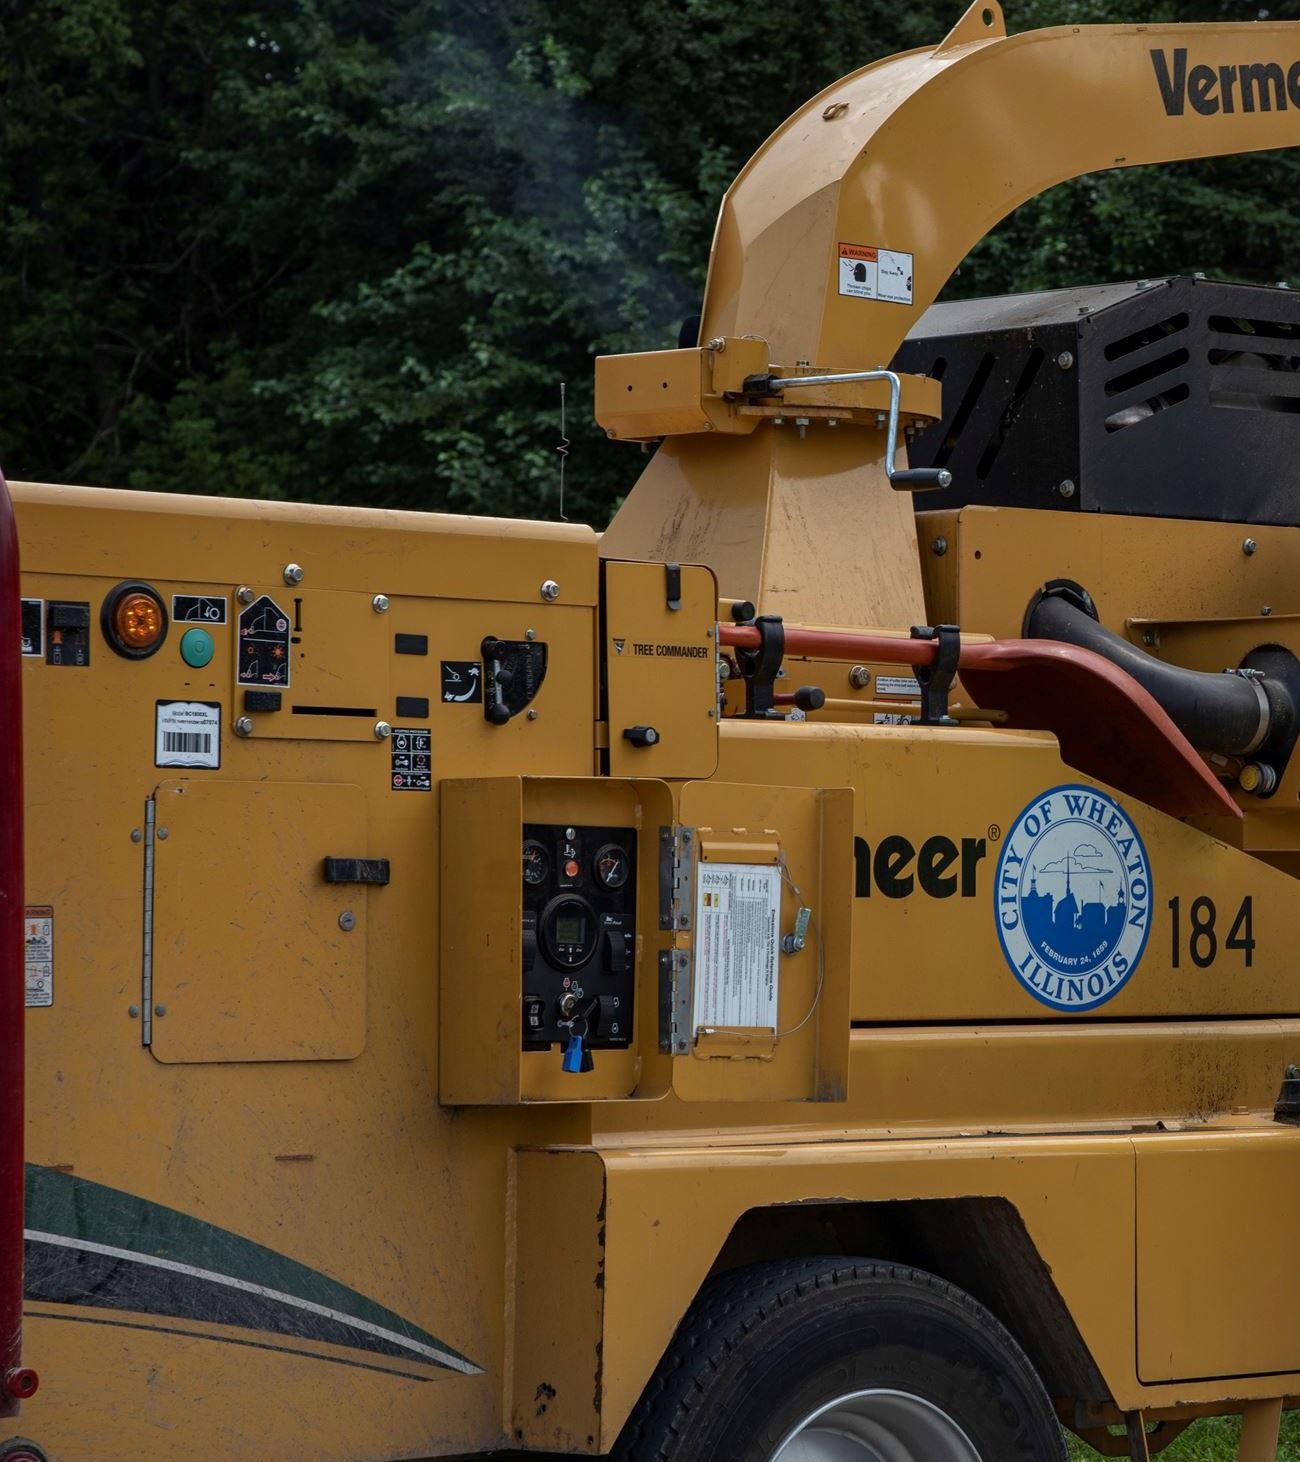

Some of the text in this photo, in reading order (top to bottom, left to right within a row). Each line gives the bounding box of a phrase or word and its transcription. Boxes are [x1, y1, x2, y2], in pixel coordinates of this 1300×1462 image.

[848, 248, 877, 260] WARNING
[633, 643, 708, 659] TREE COMMANDER
[1001, 794, 1147, 931] CITY OF WHEATON
[1168, 896, 1255, 968] 184
[1041, 940, 1108, 965] FEBRUARY 24, 1859
[1019, 951, 1129, 1001] ILLINOIS
